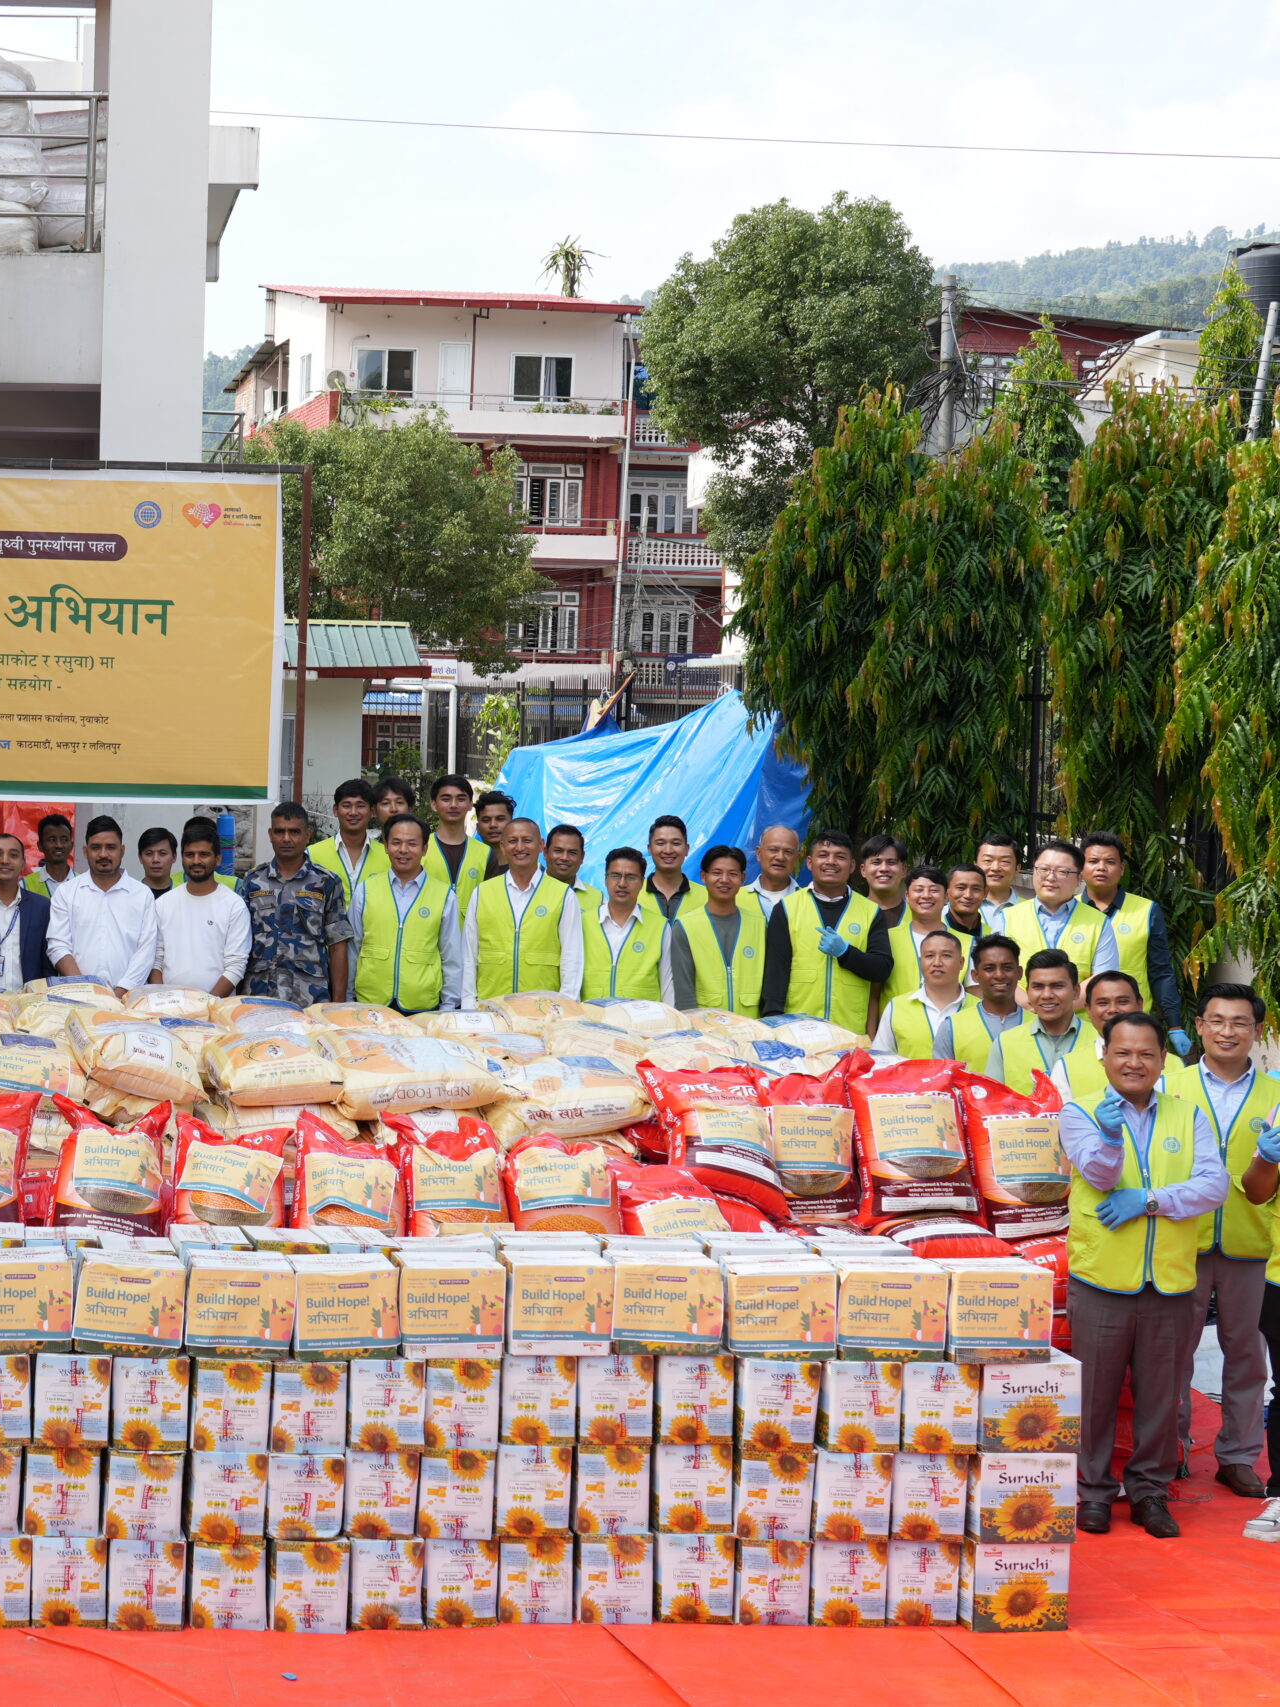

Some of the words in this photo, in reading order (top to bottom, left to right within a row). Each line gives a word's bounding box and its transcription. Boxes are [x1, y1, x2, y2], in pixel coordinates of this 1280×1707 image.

[88, 541, 116, 553] पहल
[4, 583, 175, 636] अभियान
[43, 655, 49, 667] र
[55, 654, 95, 673] रसुवा)
[100, 656, 114, 669] मा
[7, 676, 53, 692] सहयोग
[17, 713, 42, 722] प्रशासन
[80, 713, 109, 726] नुवाकोट
[83, 742, 86, 750] र
[89, 740, 121, 754] ललितपुर
[880, 1116, 905, 1126] Build
[907, 1115, 934, 1126] Hope!
[780, 1126, 807, 1136] Build
[809, 1125, 833, 1138] Hope!
[999, 1140, 1024, 1149] Build
[1026, 1138, 1052, 1149] Hope!
[84, 1145, 109, 1155] Build
[112, 1146, 140, 1158] Hope!
[196, 1292, 225, 1305] Build
[228, 1294, 260, 1309] Hope!
[521, 1288, 550, 1300] Build
[553, 1288, 586, 1304] Hope!
[848, 1294, 876, 1306] Build
[879, 1295, 912, 1310] Hope!
[957, 1295, 985, 1307] Build
[988, 1295, 1019, 1310] Hope!
[1002, 1381, 1059, 1394] Suruchi
[999, 1471, 1054, 1484] Suruchi
[995, 1557, 1048, 1571] Suruchi
